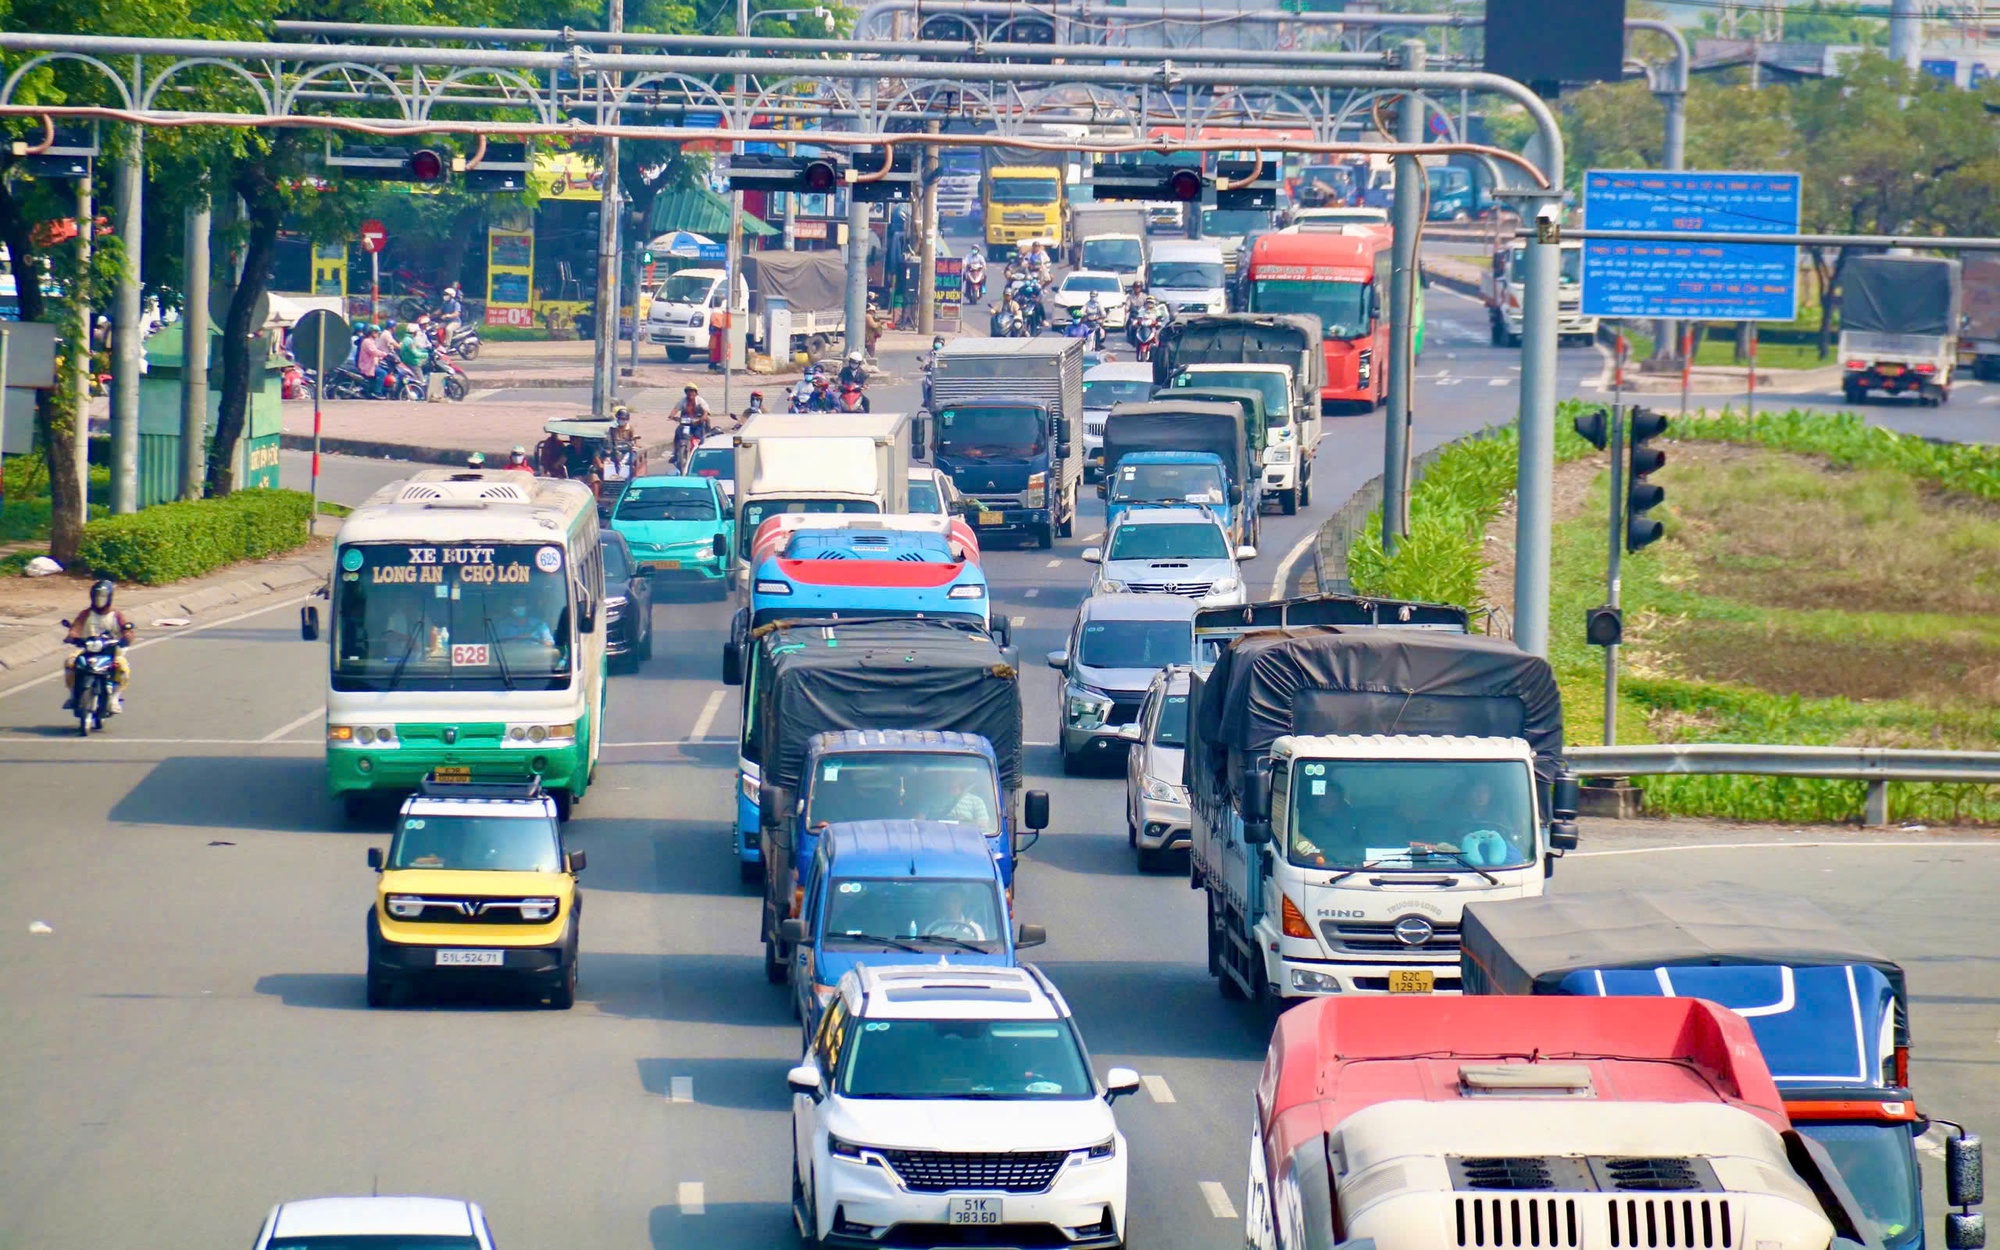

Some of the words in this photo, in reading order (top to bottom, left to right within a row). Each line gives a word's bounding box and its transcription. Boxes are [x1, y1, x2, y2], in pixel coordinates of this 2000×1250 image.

[408, 548, 436, 563] XE
[540, 552, 559, 566] 628
[372, 566, 417, 583] LONG
[419, 566, 443, 583] AN
[461, 563, 495, 585] CHỢ
[498, 561, 531, 582] LỚN
[453, 646, 487, 664] 628
[1317, 909, 1365, 918] HINO
[1402, 972, 1420, 981] 62C
[1395, 982, 1428, 992] 129.37
[965, 1199, 987, 1211] 51K
[955, 1212, 997, 1223] 383.60
